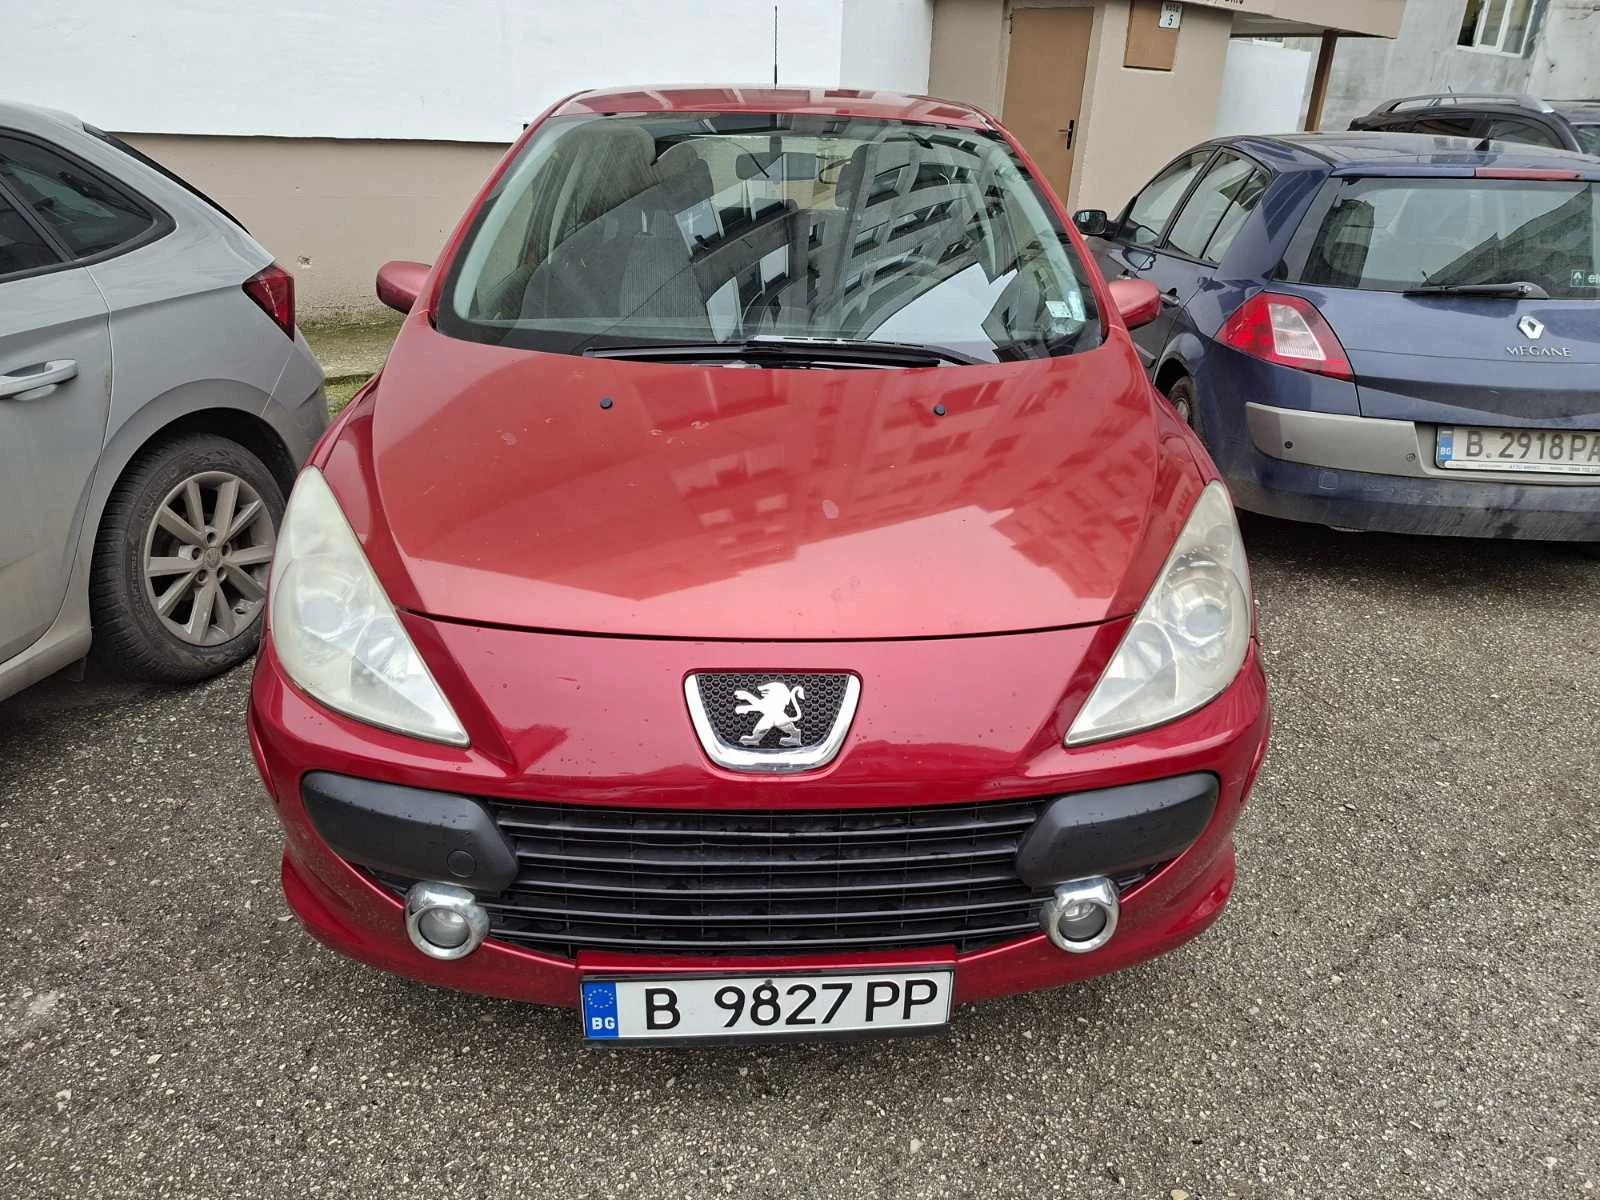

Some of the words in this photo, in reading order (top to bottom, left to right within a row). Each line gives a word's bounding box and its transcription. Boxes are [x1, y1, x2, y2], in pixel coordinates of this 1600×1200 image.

[1505, 345, 1572, 358] MEGANE
[1440, 447, 1451, 455] BG
[1466, 430, 1484, 457] B
[1499, 431, 1564, 460] 2918
[645, 987, 681, 1030] B
[714, 982, 853, 1028] 9827
[865, 978, 938, 1023] PP
[591, 1016, 616, 1030] BG
